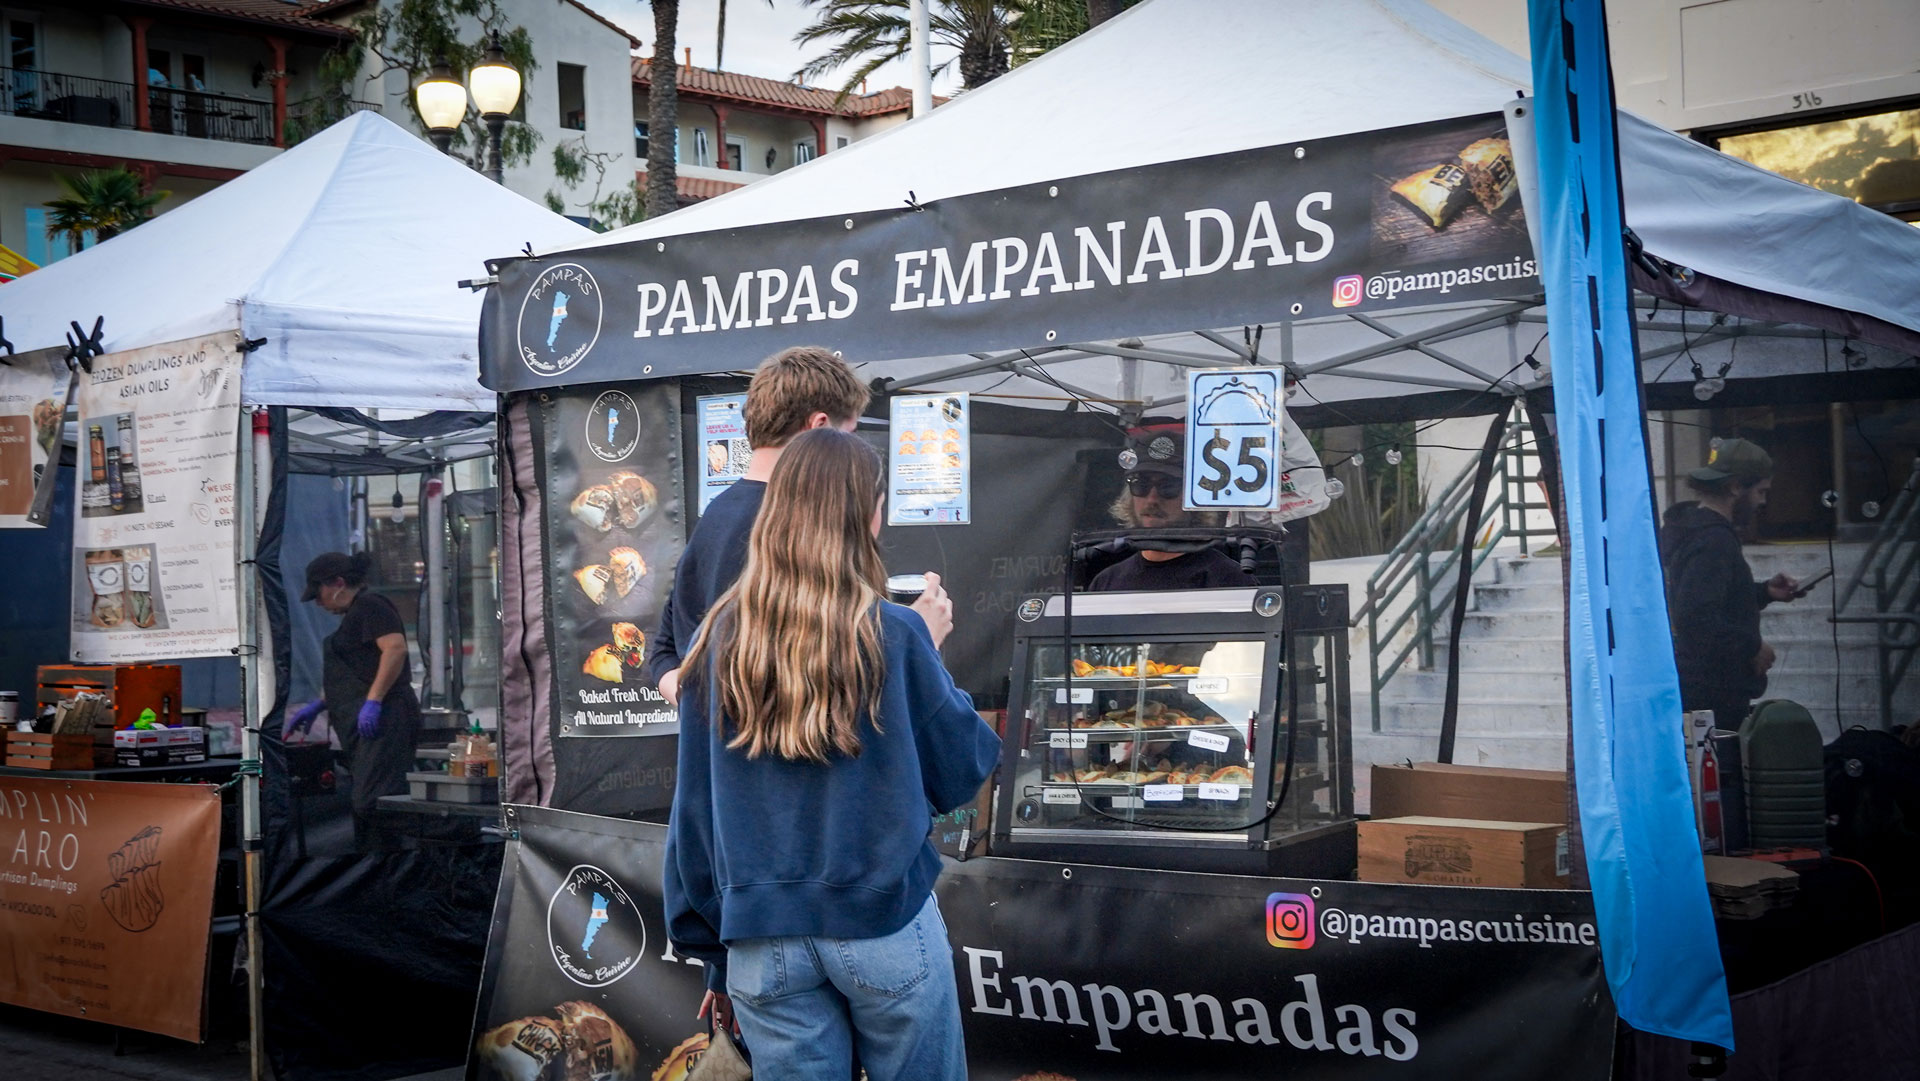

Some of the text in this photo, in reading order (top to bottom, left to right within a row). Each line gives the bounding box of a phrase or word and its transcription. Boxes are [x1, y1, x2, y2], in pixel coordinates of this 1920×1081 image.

[634, 191, 1335, 338] PAMPAS EMPANADAS
[532, 269, 592, 300] PAMPAS
[91, 350, 206, 382] FROZEN DUMPLINGS AND
[119, 378, 169, 398] ASIAN OILS
[594, 394, 632, 415] PAMPAS
[1197, 428, 1267, 501] $5
[207, 483, 233, 493] WE USE
[578, 687, 669, 705] Baked Fresh Dai
[574, 709, 678, 728] All Natural Ingredients
[11, 829, 79, 871] ARO
[30, 871, 78, 894] Dumplings
[566, 871, 626, 905] PAMPAS
[1433, 875, 1481, 885] CHATEAU
[1320, 907, 1595, 948] @pampascuisine
[556, 945, 631, 980] Argentine Cuisine
[962, 945, 1419, 1062] Empanadas
